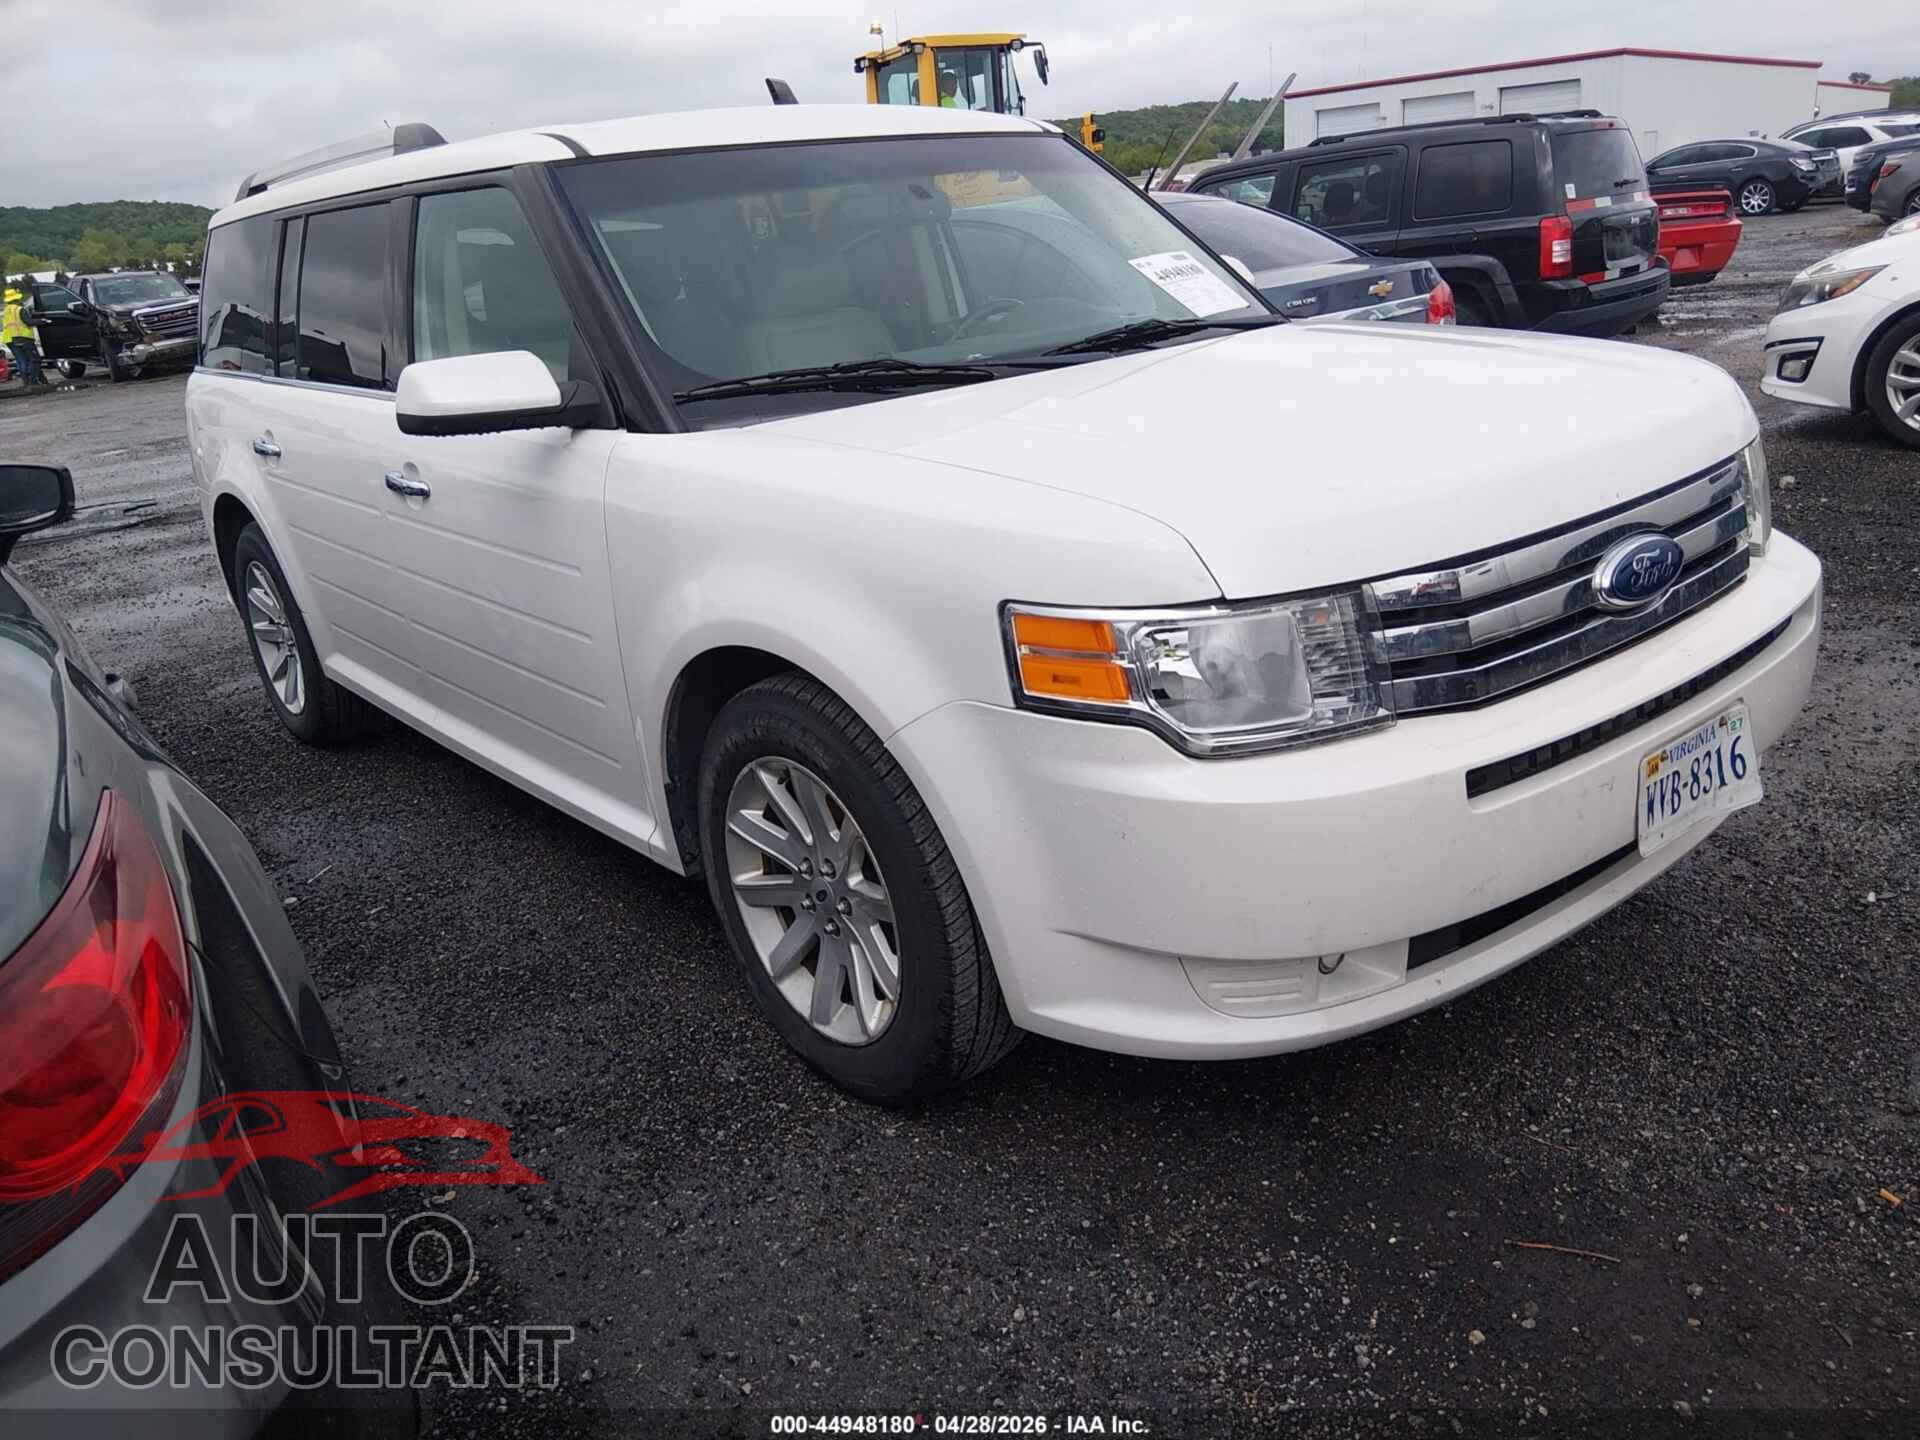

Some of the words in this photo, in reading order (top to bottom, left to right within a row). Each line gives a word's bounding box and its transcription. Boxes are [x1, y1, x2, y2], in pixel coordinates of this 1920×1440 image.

[1631, 548, 1674, 588] Ford
[1668, 724, 1716, 763] VIRGINIA
[1729, 717, 1743, 731] 27
